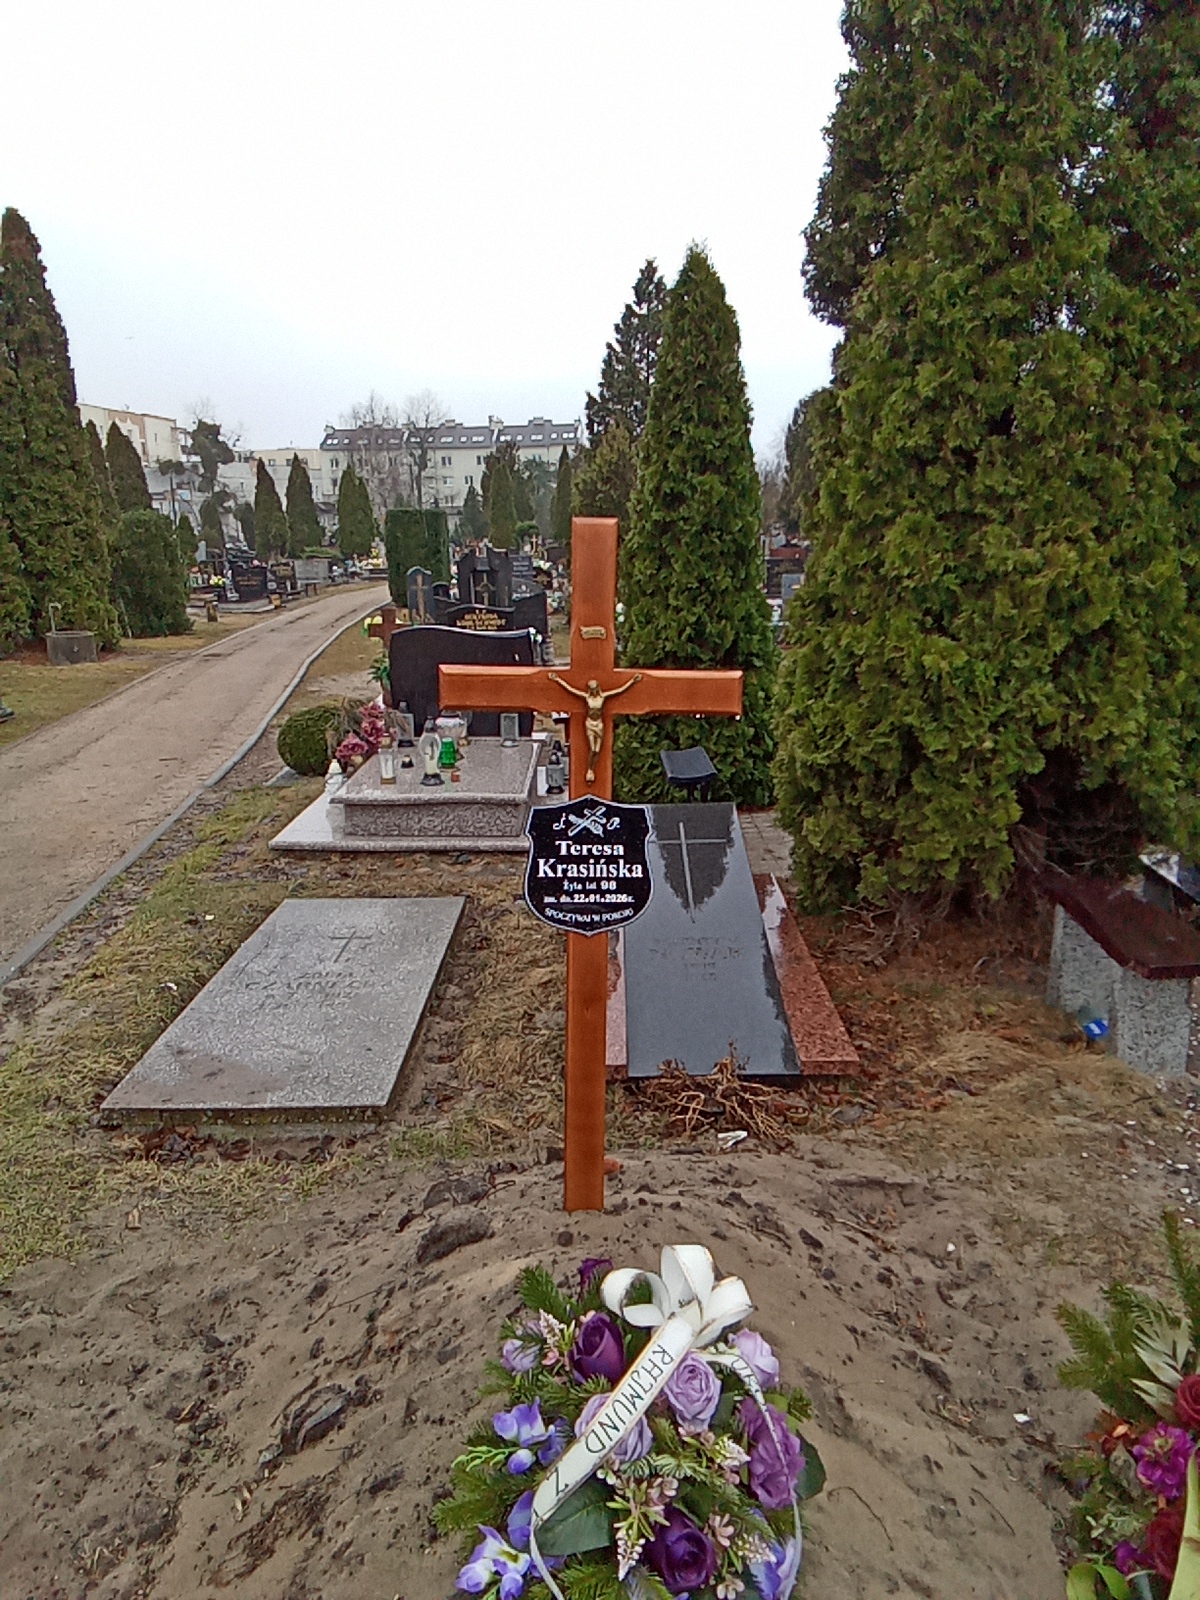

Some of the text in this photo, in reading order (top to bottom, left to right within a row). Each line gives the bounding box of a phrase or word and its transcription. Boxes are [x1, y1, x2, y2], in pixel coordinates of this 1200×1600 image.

[555, 841, 624, 856] Teresa
[537, 858, 643, 878] Krasińska
[544, 907, 633, 923] SPOCZYWAJ W POKOJU
[585, 1344, 674, 1454] RAJMUND
